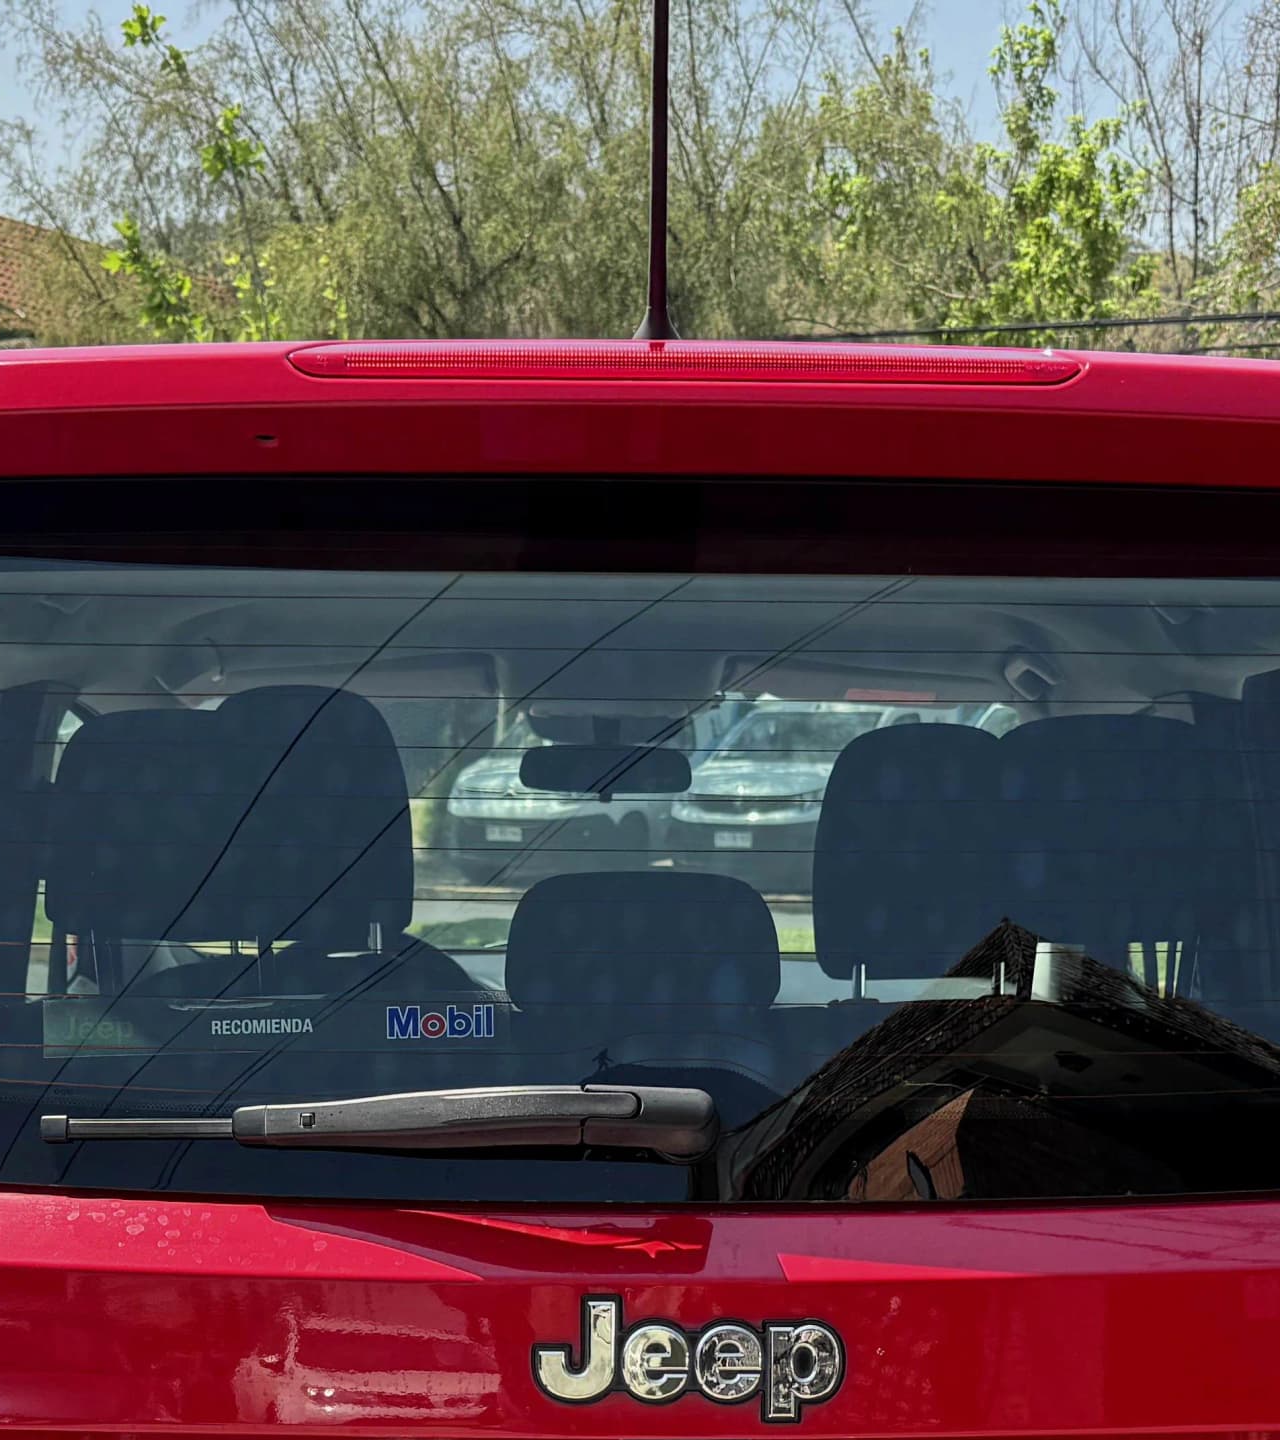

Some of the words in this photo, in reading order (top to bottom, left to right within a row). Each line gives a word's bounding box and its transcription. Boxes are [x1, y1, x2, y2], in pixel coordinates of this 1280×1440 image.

[211, 1018, 313, 1036] RECOMIENDA
[386, 1005, 495, 1039] Mobil
[532, 1294, 845, 1422] Jeep
